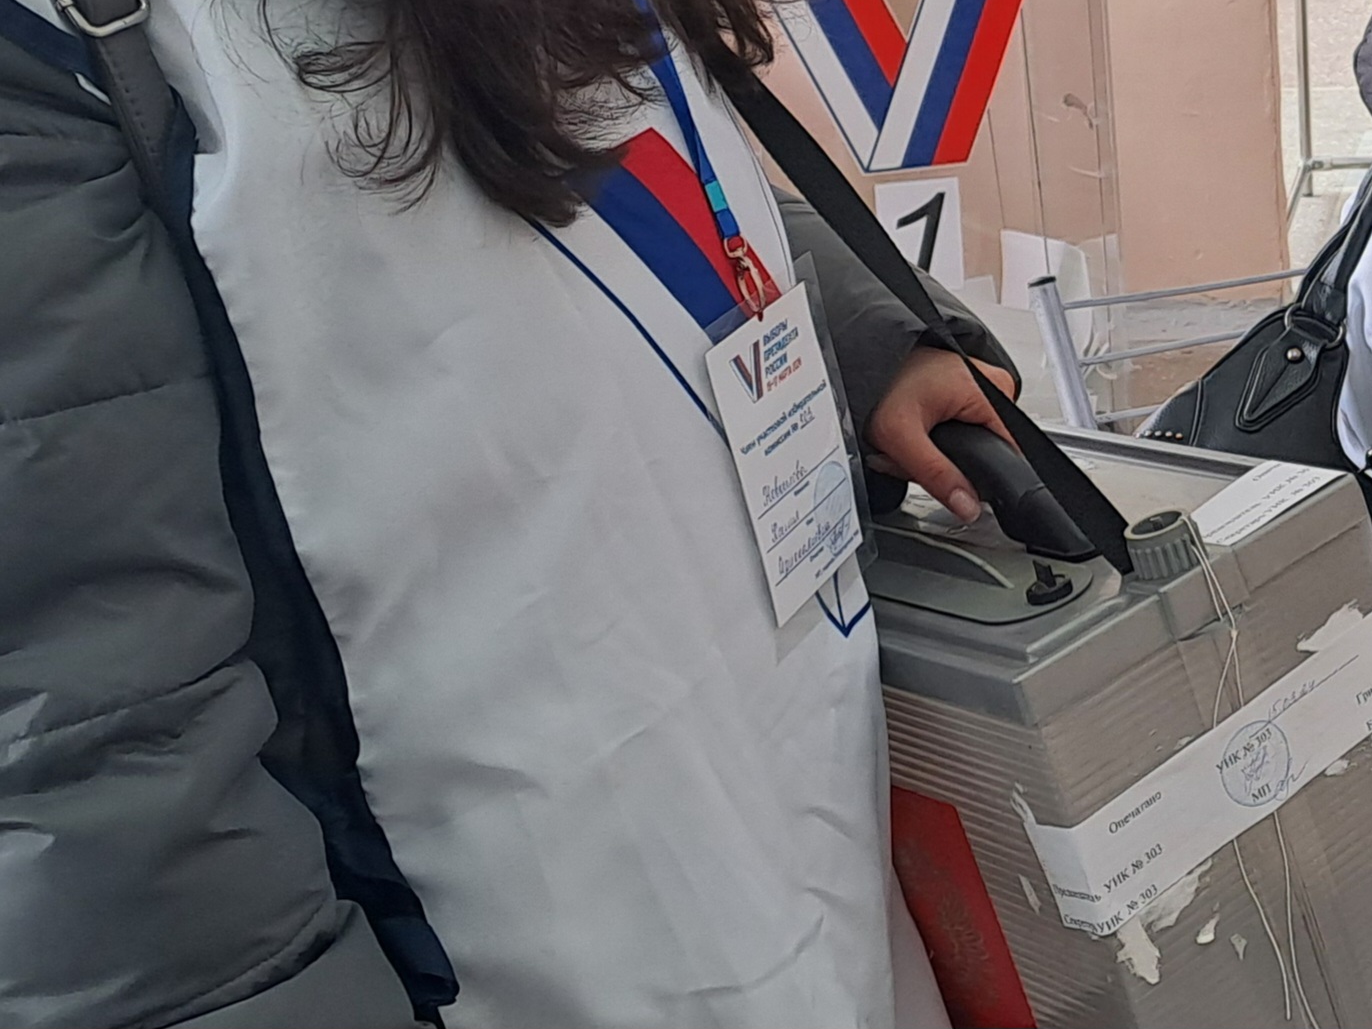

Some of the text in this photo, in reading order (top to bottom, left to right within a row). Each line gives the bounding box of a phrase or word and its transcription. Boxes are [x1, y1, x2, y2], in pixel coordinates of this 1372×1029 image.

[1215, 750, 1244, 775] УИК
[1254, 726, 1274, 749] 303
[1108, 790, 1163, 835] Опечатано
[1103, 867, 1131, 894] УИК
[1145, 842, 1164, 865] 303
[1095, 909, 1125, 934] УИК
[1140, 883, 1160, 904] 303
